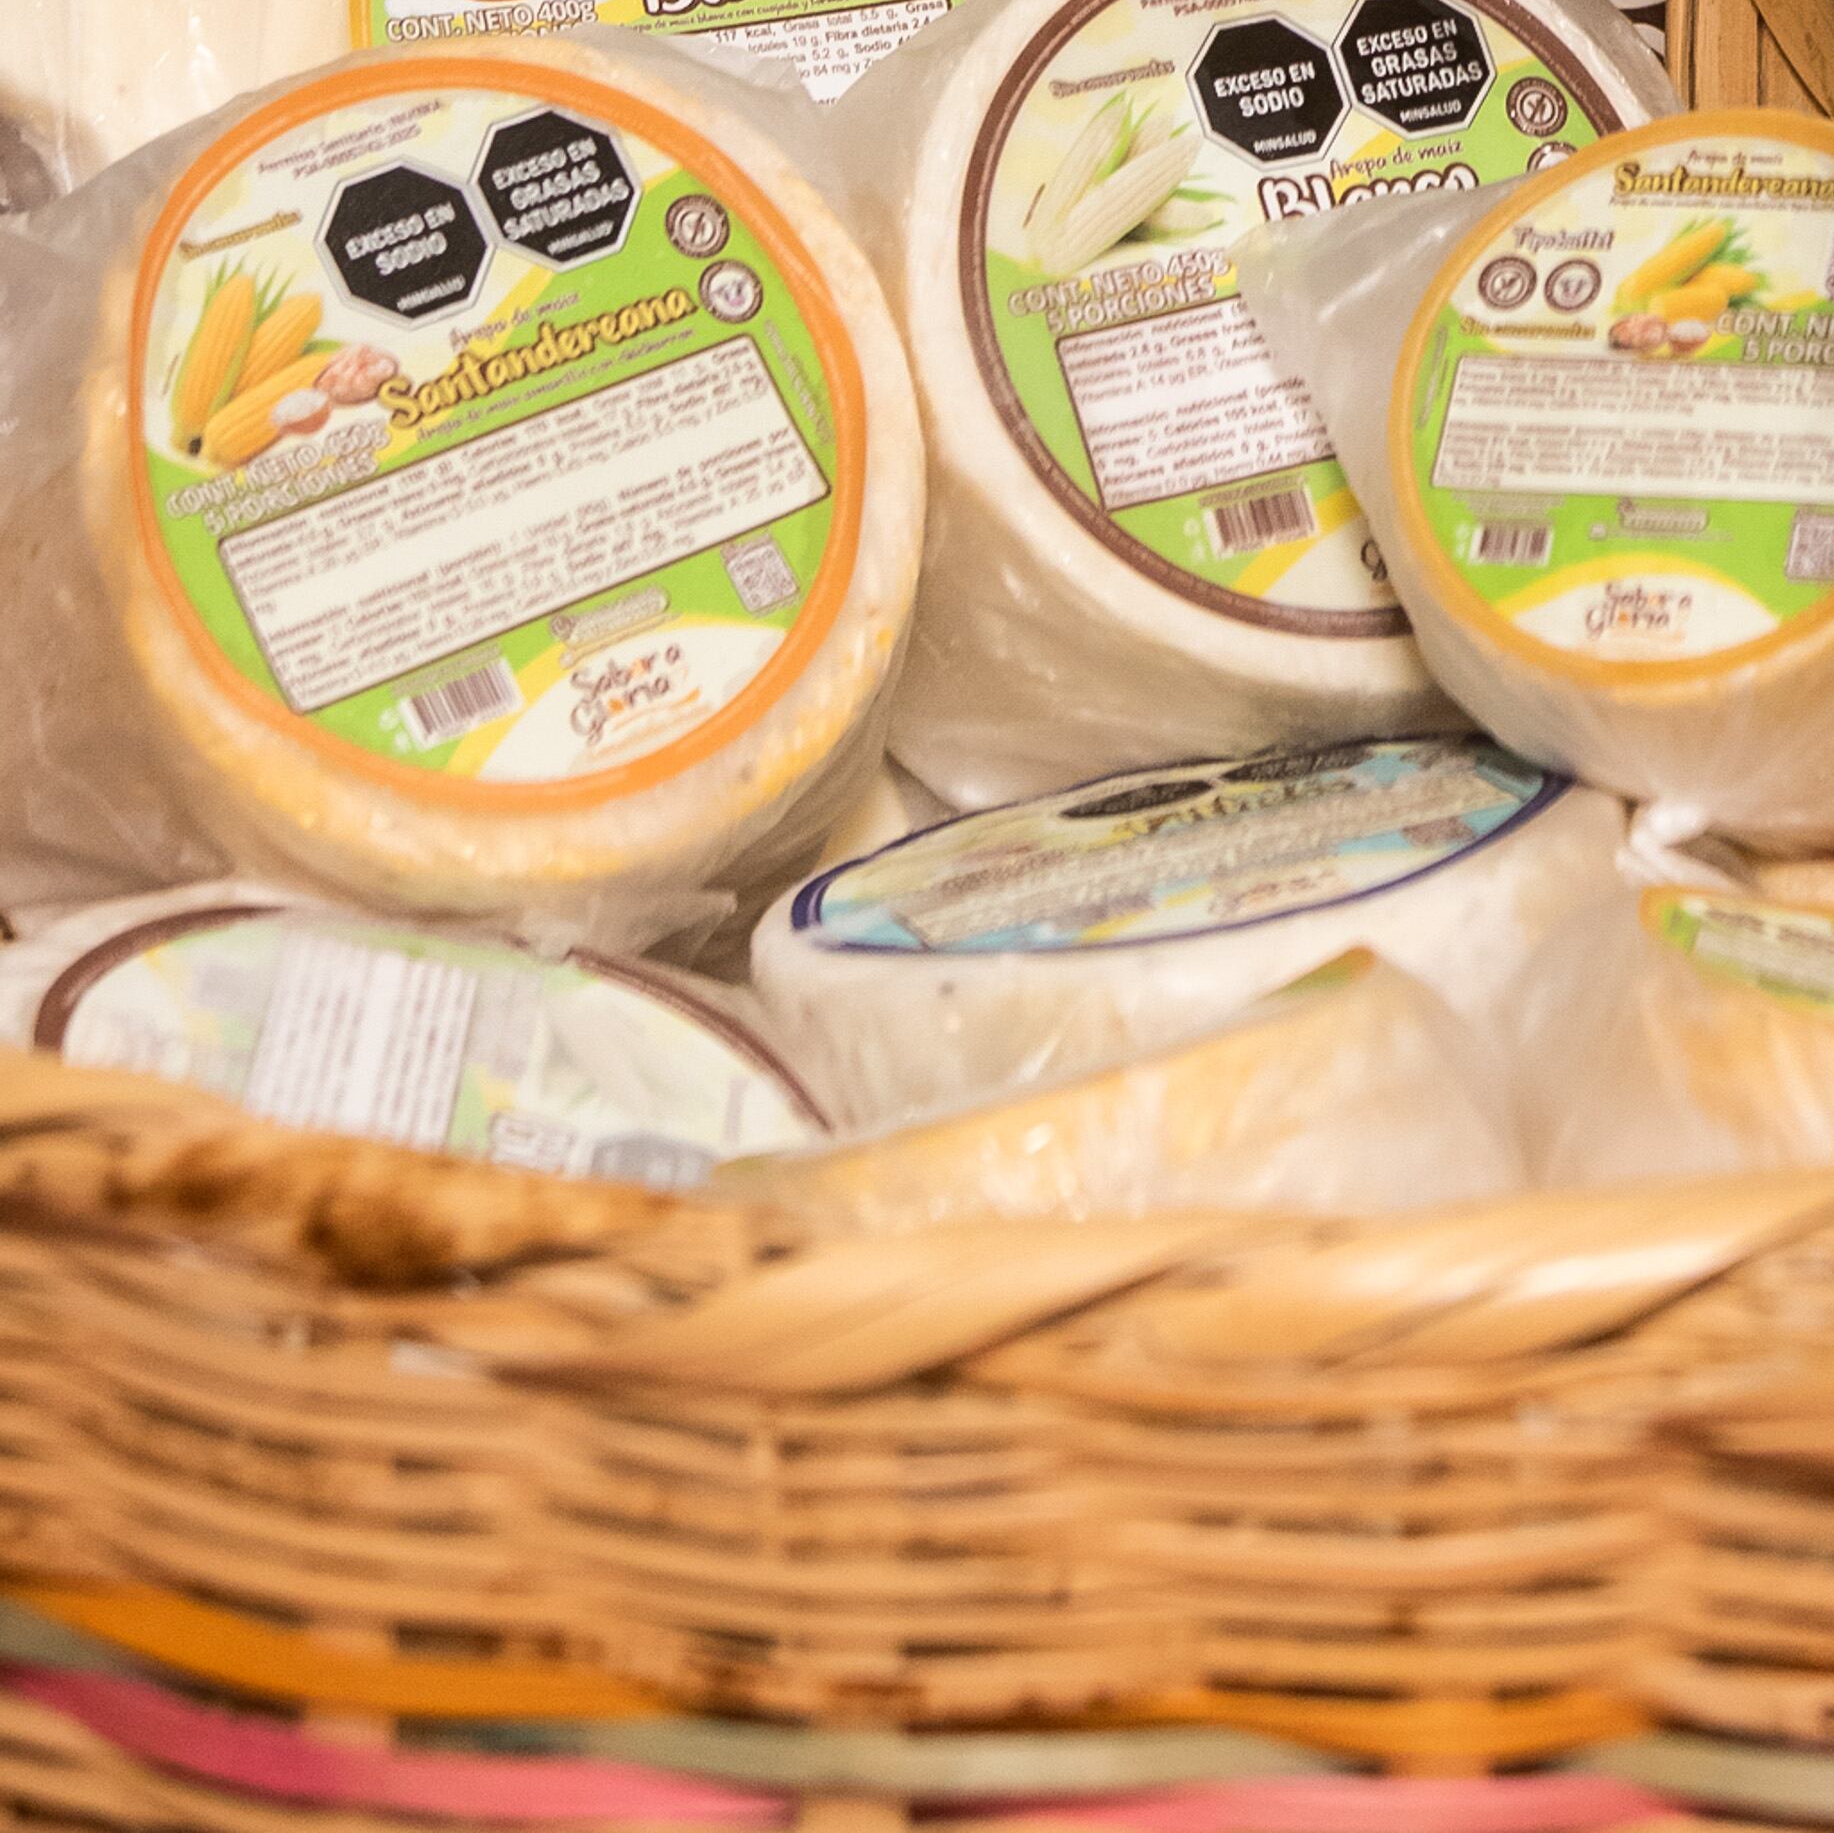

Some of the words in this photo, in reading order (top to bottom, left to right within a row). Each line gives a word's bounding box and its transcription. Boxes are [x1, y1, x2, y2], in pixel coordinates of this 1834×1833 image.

[464, 4, 534, 35] NETO
[783, 18, 820, 33] Grasa
[827, 13, 853, 27] total
[825, 28, 858, 44] Fibra
[1356, 24, 1428, 57] EXCESO
[1433, 18, 1459, 41] EN
[854, 38, 892, 54] Sodio
[1371, 40, 1458, 79] GRASAS
[1213, 65, 1287, 99] EXCESO
[1290, 60, 1316, 83] EN
[1361, 59, 1484, 106] SATURADAS
[1239, 85, 1305, 119] SODIO
[1399, 98, 1463, 125] MINSALUD
[1253, 129, 1317, 155] MINSALUD
[1090, 258, 1165, 296] NETO
[1065, 275, 1217, 332] PORCIONES
[378, 285, 699, 430] Santandereana
